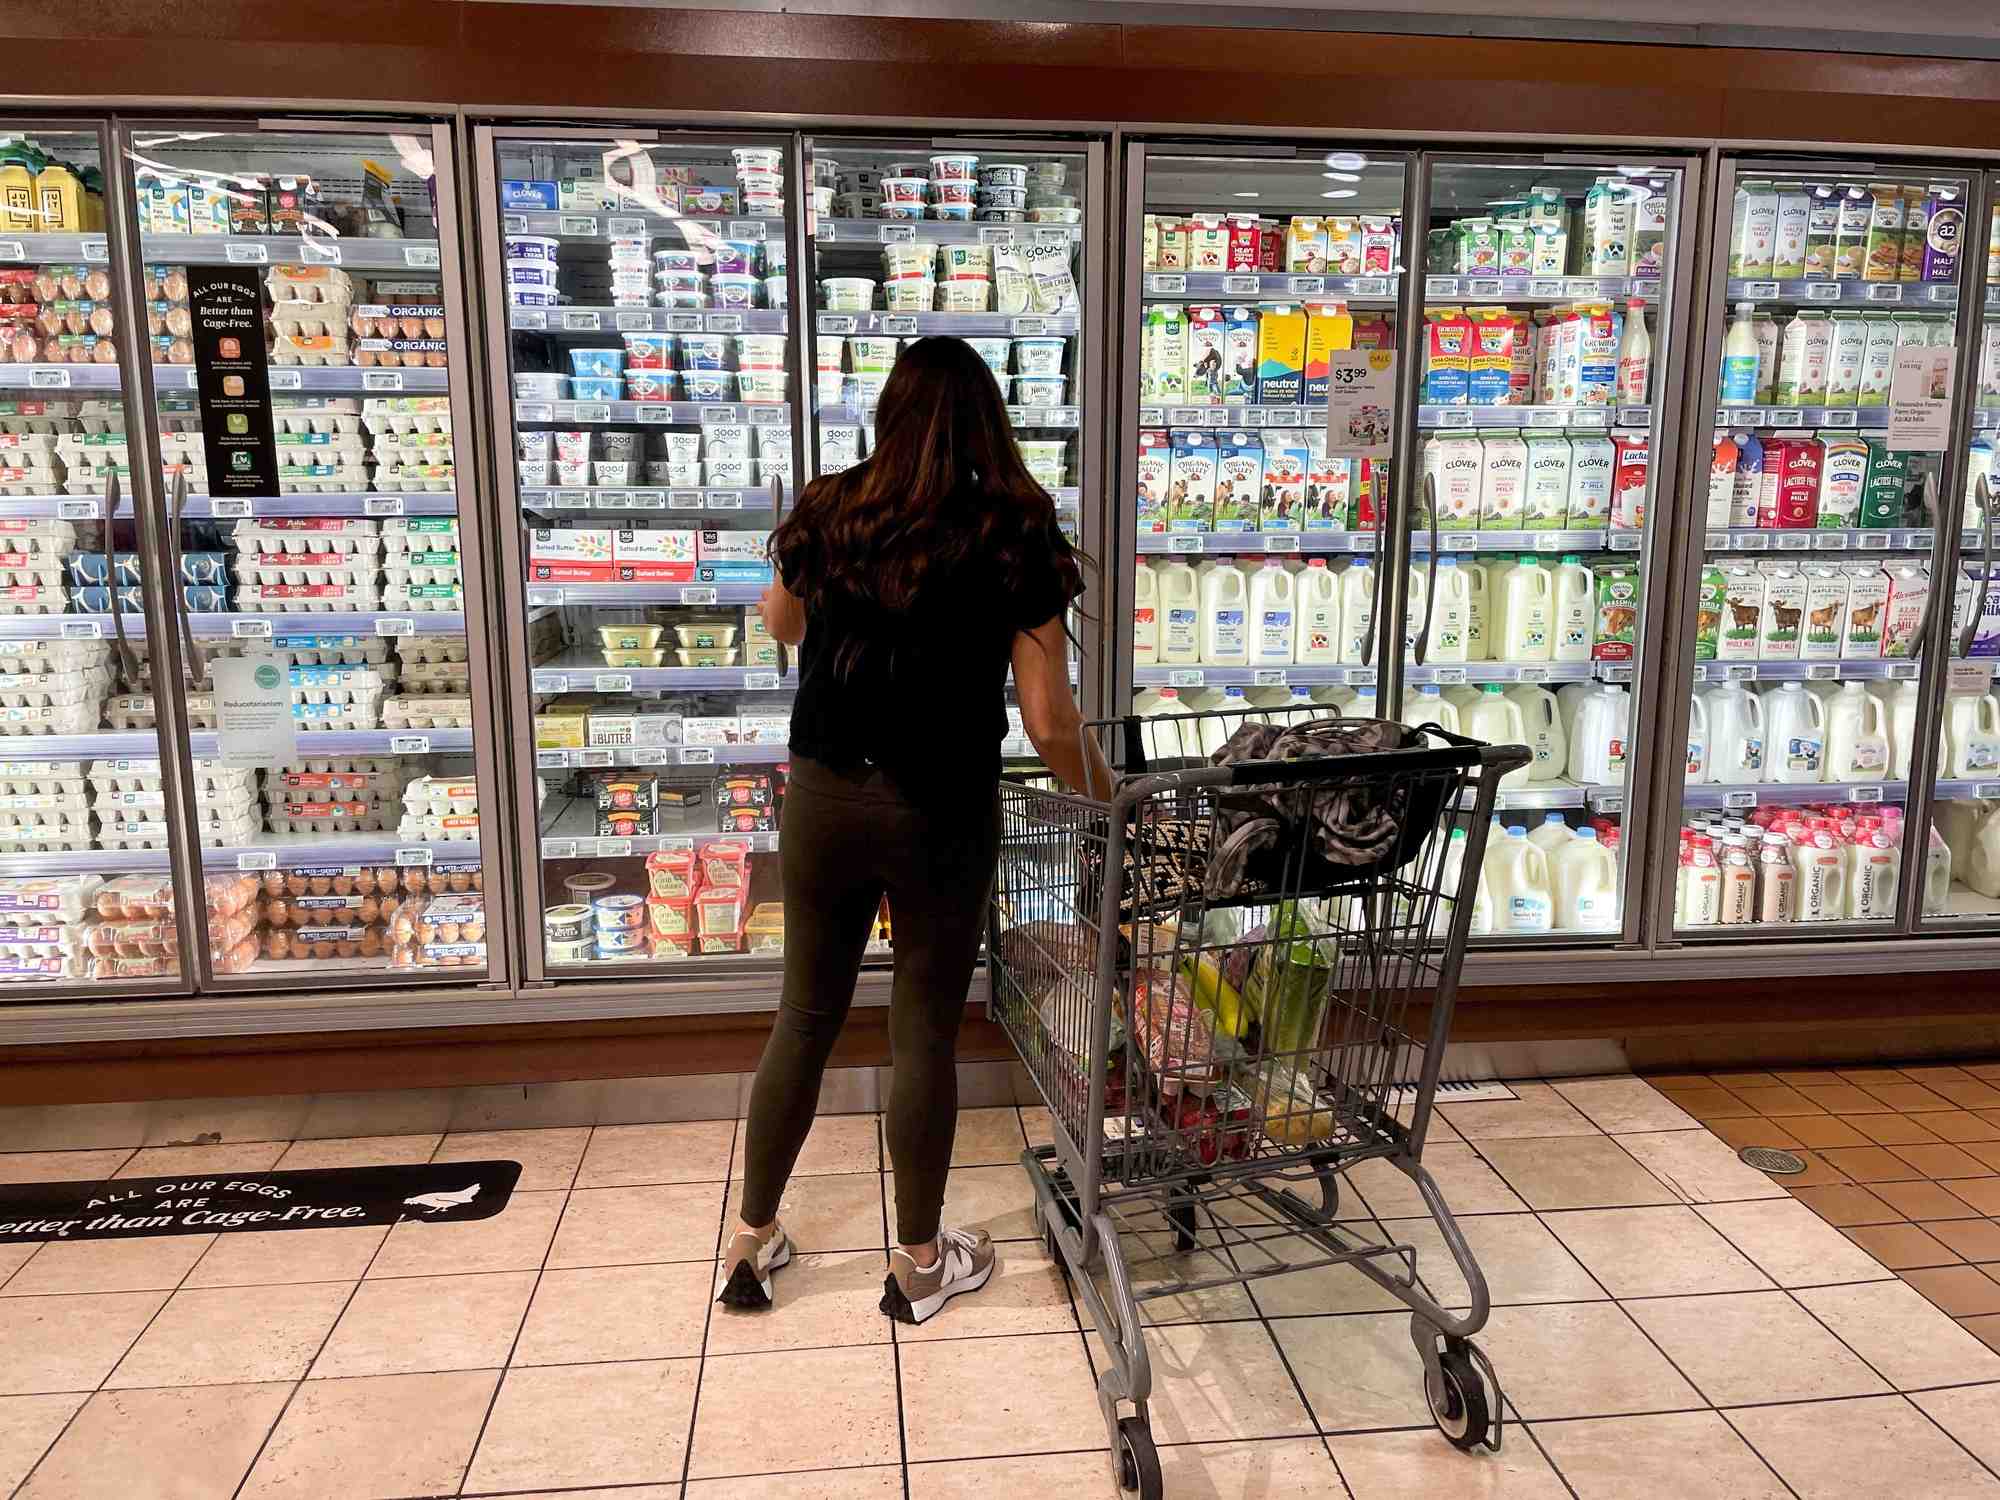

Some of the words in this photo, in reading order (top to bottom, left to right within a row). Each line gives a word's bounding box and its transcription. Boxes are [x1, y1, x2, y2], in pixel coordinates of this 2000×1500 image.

[193, 286, 209, 298] ALL
[210, 282, 230, 290] OUR
[231, 283, 257, 298] EGGS
[200, 306, 228, 315] Better
[231, 306, 253, 315] than
[391, 307, 445, 316] ORGANIC
[203, 318, 253, 329] Cage-Free.
[394, 341, 447, 350] ORGANIC
[1263, 380, 1299, 388] neutral
[713, 428, 740, 437] good
[827, 429, 853, 439] good
[606, 435, 631, 444] good
[714, 462, 741, 472] good
[821, 463, 848, 472] good
[1446, 459, 1477, 470] CLOVER
[1490, 459, 1522, 469] CLOVER
[1534, 459, 1565, 469] CLOVER
[1577, 459, 1609, 469] CLOVER
[1789, 460, 1816, 468] CLOVER
[1833, 459, 1860, 467] CLOVER
[1875, 460, 1902, 469] CLOVER
[599, 464, 624, 473] good
[597, 734, 632, 745] BUTTER
[1811, 865, 1821, 908] ORGANIC
[1861, 865, 1872, 907] ORGANIC
[1736, 881, 1744, 915] ORGANIC
[1778, 881, 1786, 915] ORGANIC
[87, 1190, 143, 1208] ALL
[155, 1181, 217, 1194] OUR
[223, 1181, 292, 1199] EGGS
[154, 1197, 210, 1209] ARE
[0, 1220, 83, 1237] etter
[85, 1214, 174, 1231] than
[182, 1205, 368, 1227] Cage-Free.
